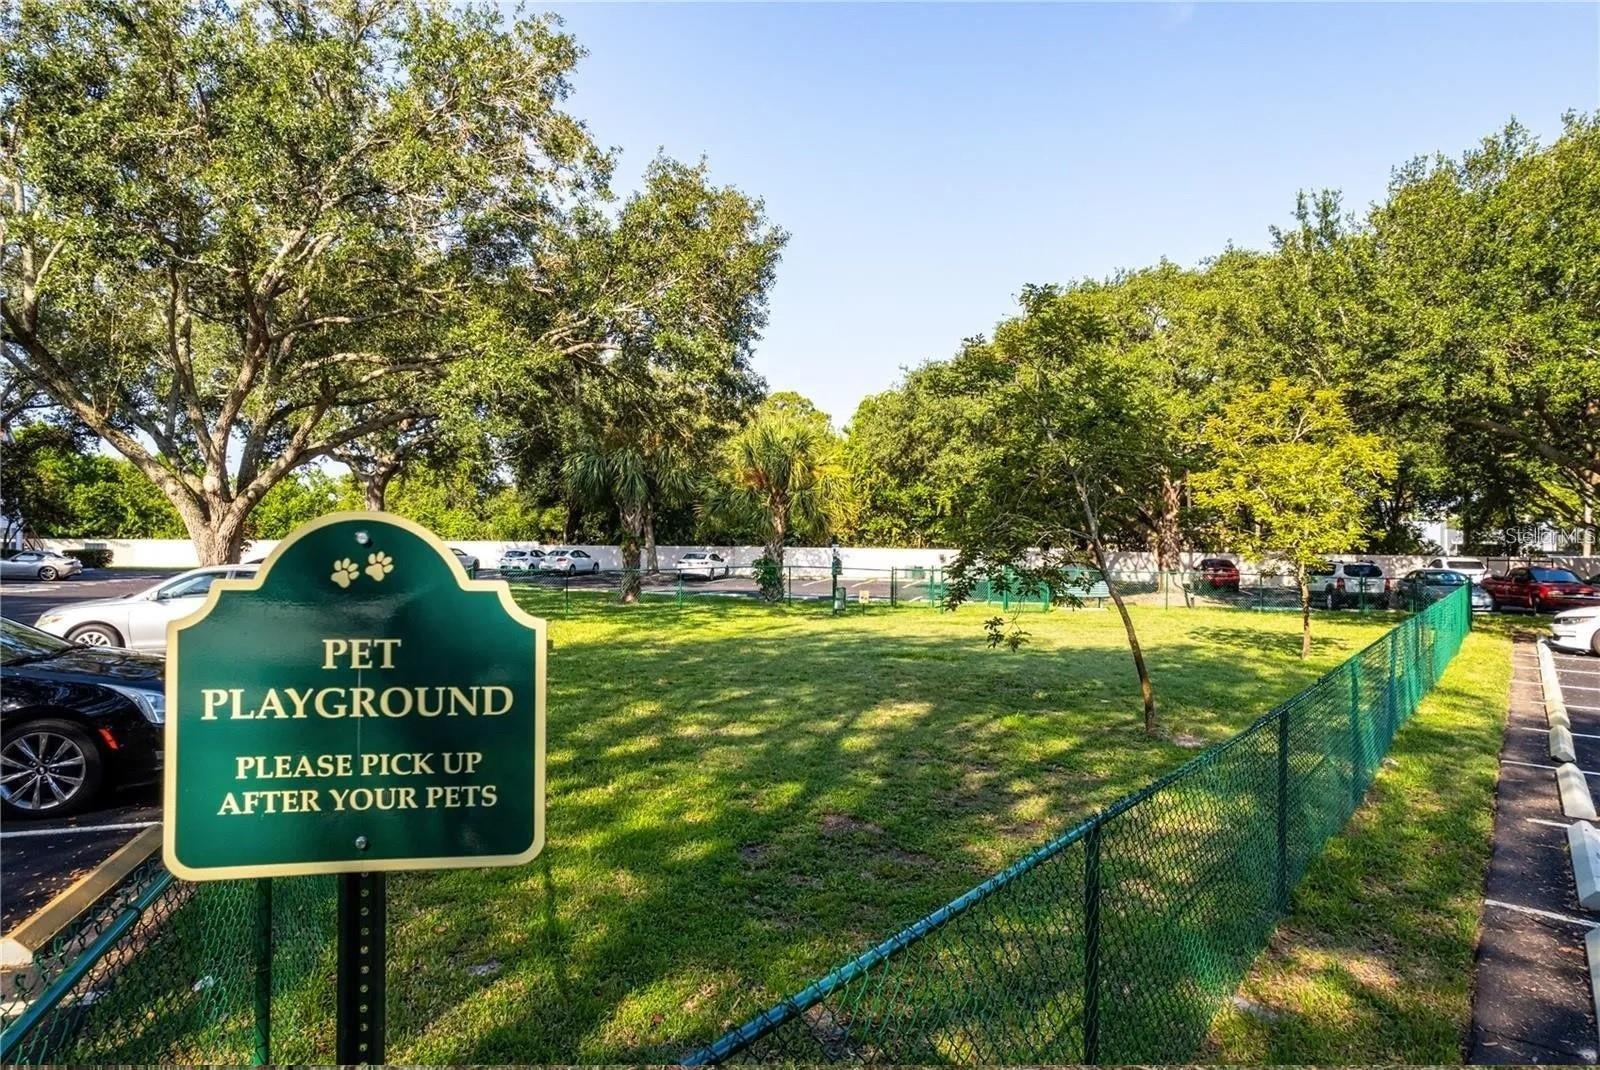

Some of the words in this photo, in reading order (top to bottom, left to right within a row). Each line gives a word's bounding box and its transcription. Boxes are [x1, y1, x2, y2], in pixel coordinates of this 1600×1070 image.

[322, 639, 401, 670] PET
[201, 687, 514, 721] PLAYGROUND
[235, 755, 353, 780] PLEASE
[360, 753, 435, 776] PICK
[443, 752, 483, 775] UP
[217, 791, 321, 816] AFTER
[328, 788, 418, 811] YOUR
[426, 786, 498, 809] PETS
